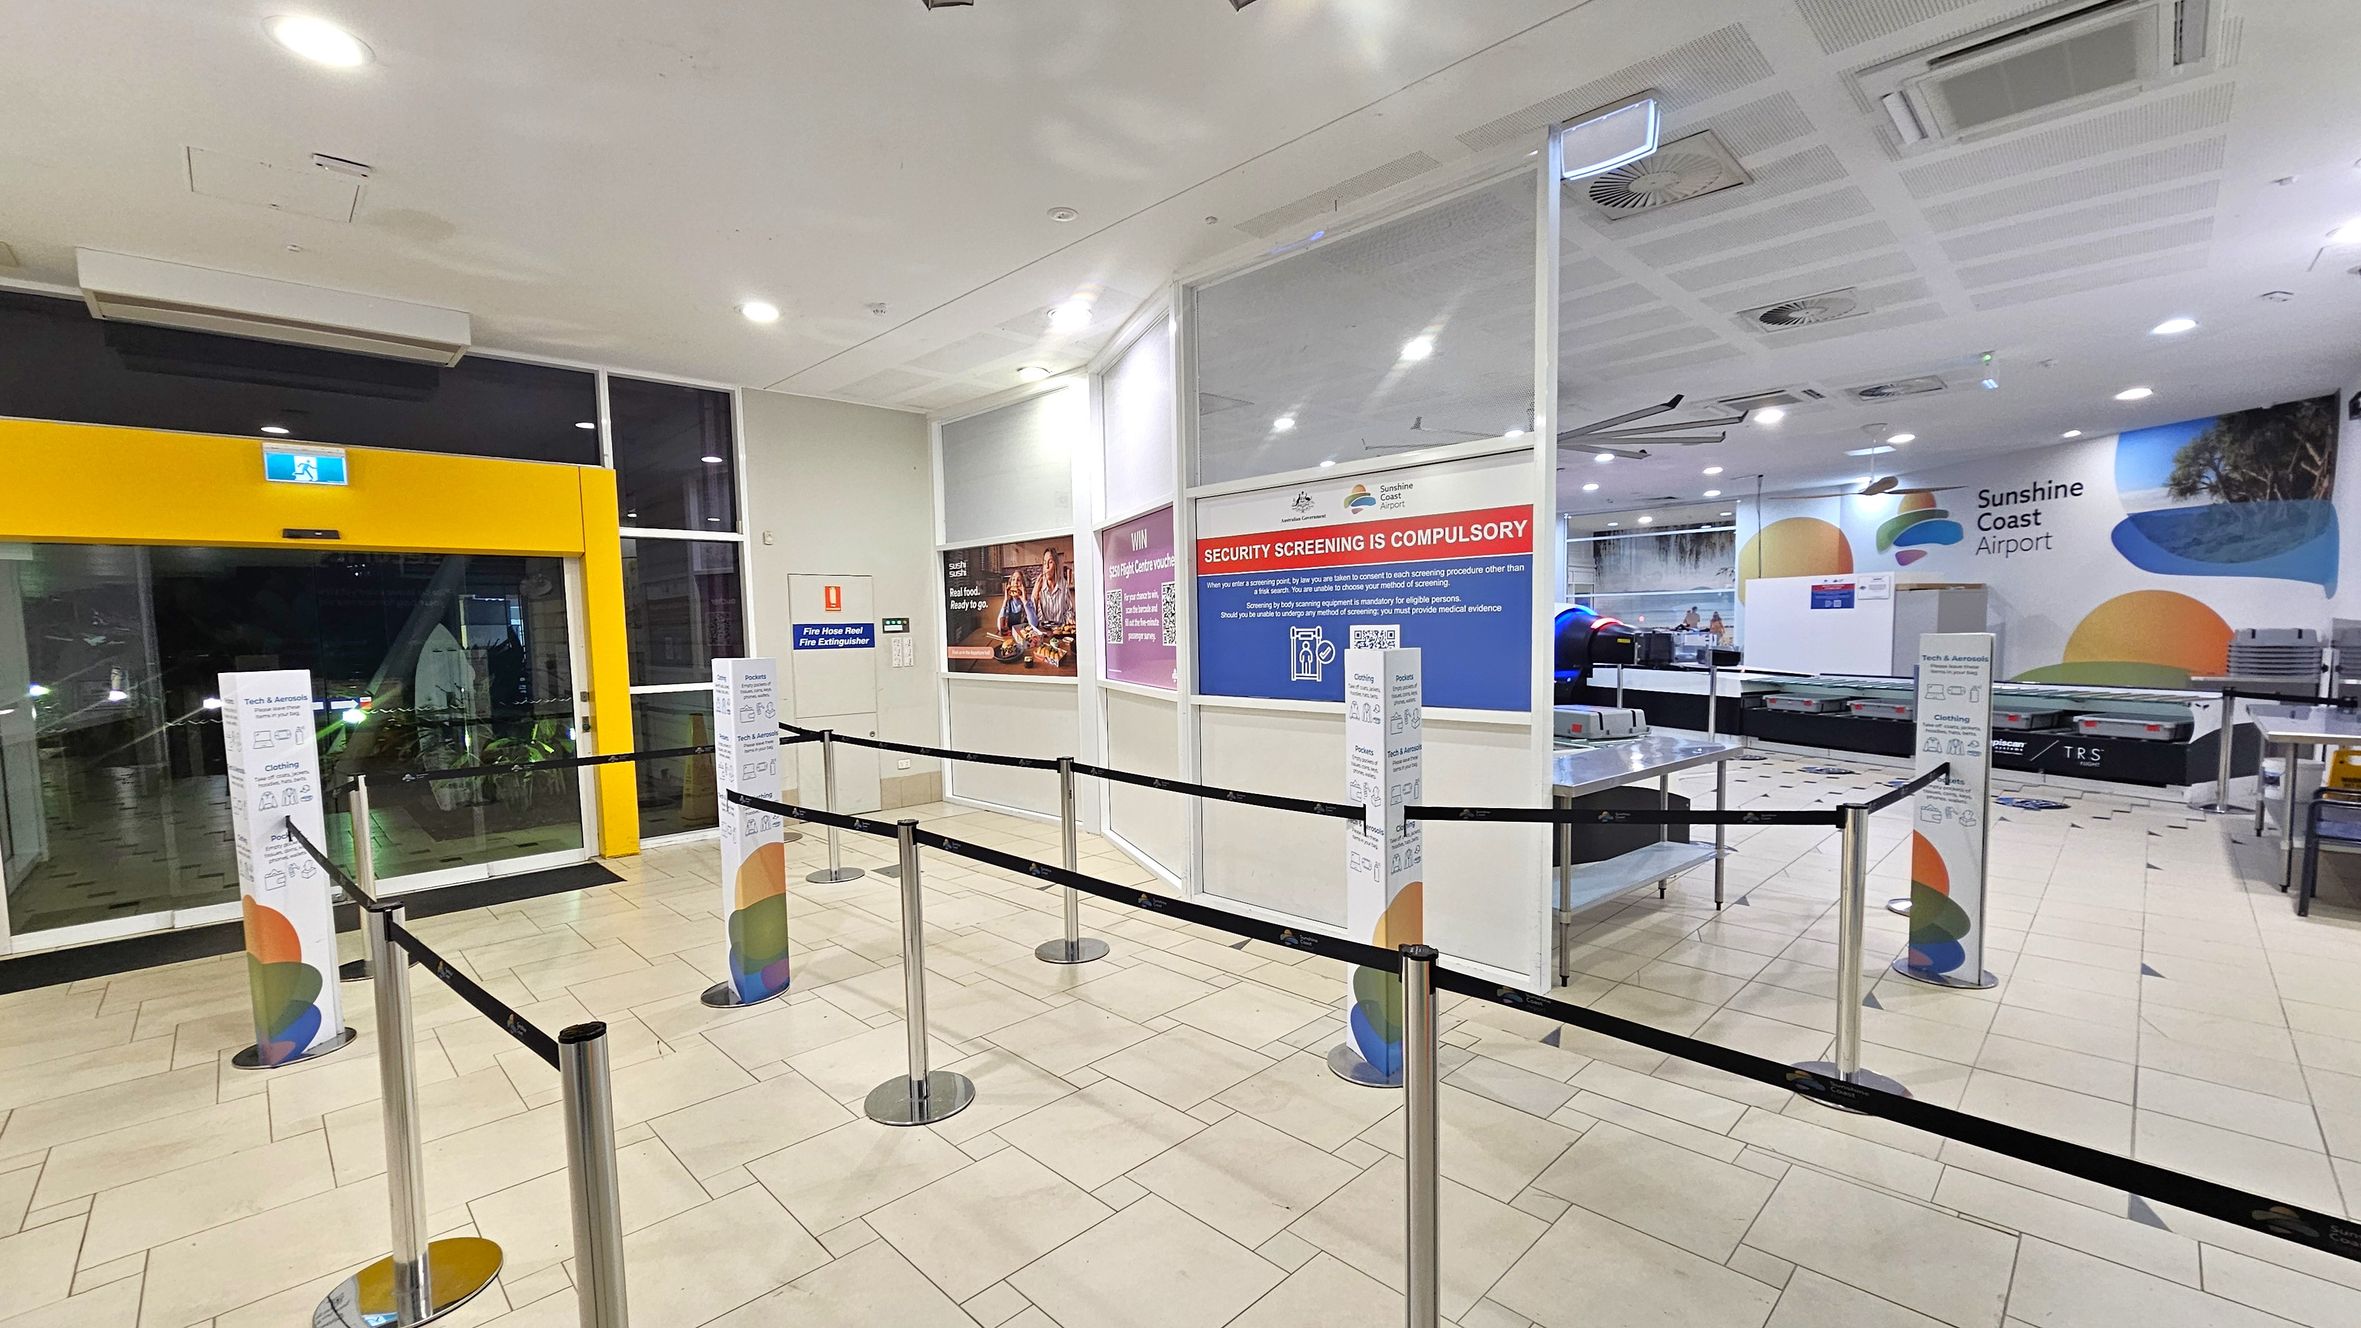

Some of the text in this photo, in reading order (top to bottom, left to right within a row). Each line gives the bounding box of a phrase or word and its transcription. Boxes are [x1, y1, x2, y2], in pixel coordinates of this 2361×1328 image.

[1380, 482, 1414, 492] Sunshine
[1380, 493, 1402, 501] Coast
[1978, 480, 2084, 508] Sunshine
[1380, 500, 1405, 510] Airport
[1977, 508, 2042, 532] Coast
[1130, 528, 1148, 551] WIN
[1204, 520, 1528, 563] SECURITY SCREENING IS COMPULSORY
[1976, 532, 2053, 558] Airport
[949, 561, 966, 570] sushi
[1109, 552, 1176, 580] $250 Flight Centre vouche
[949, 570, 966, 578] sushi
[1412, 569, 1444, 578] screening
[1446, 566, 1483, 576] procedure
[1485, 565, 1506, 574] other
[1415, 580, 1450, 588] screening.
[950, 586, 980, 597] Real food.
[950, 600, 988, 611] Ready to go.
[1296, 600, 1320, 608] scanning
[1322, 600, 1352, 608] equipment
[1360, 598, 1394, 606] mandatory
[1406, 596, 1430, 604] eligible
[1431, 596, 1461, 604] persons.
[1282, 610, 1304, 618] undergo
[1412, 606, 1437, 614] provide
[1438, 605, 1466, 613] medical
[1468, 604, 1502, 612] evidence
[804, 626, 864, 636] Fire Hose Reel
[800, 637, 870, 646] Fire Extinguisher
[1354, 673, 1374, 684] Clothing
[1396, 674, 1414, 683] Pockets
[274, 694, 308, 702] Aerosols
[1934, 714, 1970, 724] Clothing
[757, 730, 778, 739] Aerosols
[1992, 738, 2025, 748] piscan
[1355, 744, 1374, 756] Pockets
[1388, 750, 1400, 758] Tech
[1404, 744, 1422, 754] Aerosols
[2064, 746, 2101, 761] TRS
[265, 762, 300, 772] Clothing
[2330, 1224, 2361, 1238] Sun
[2329, 1232, 2361, 1247] Coa
